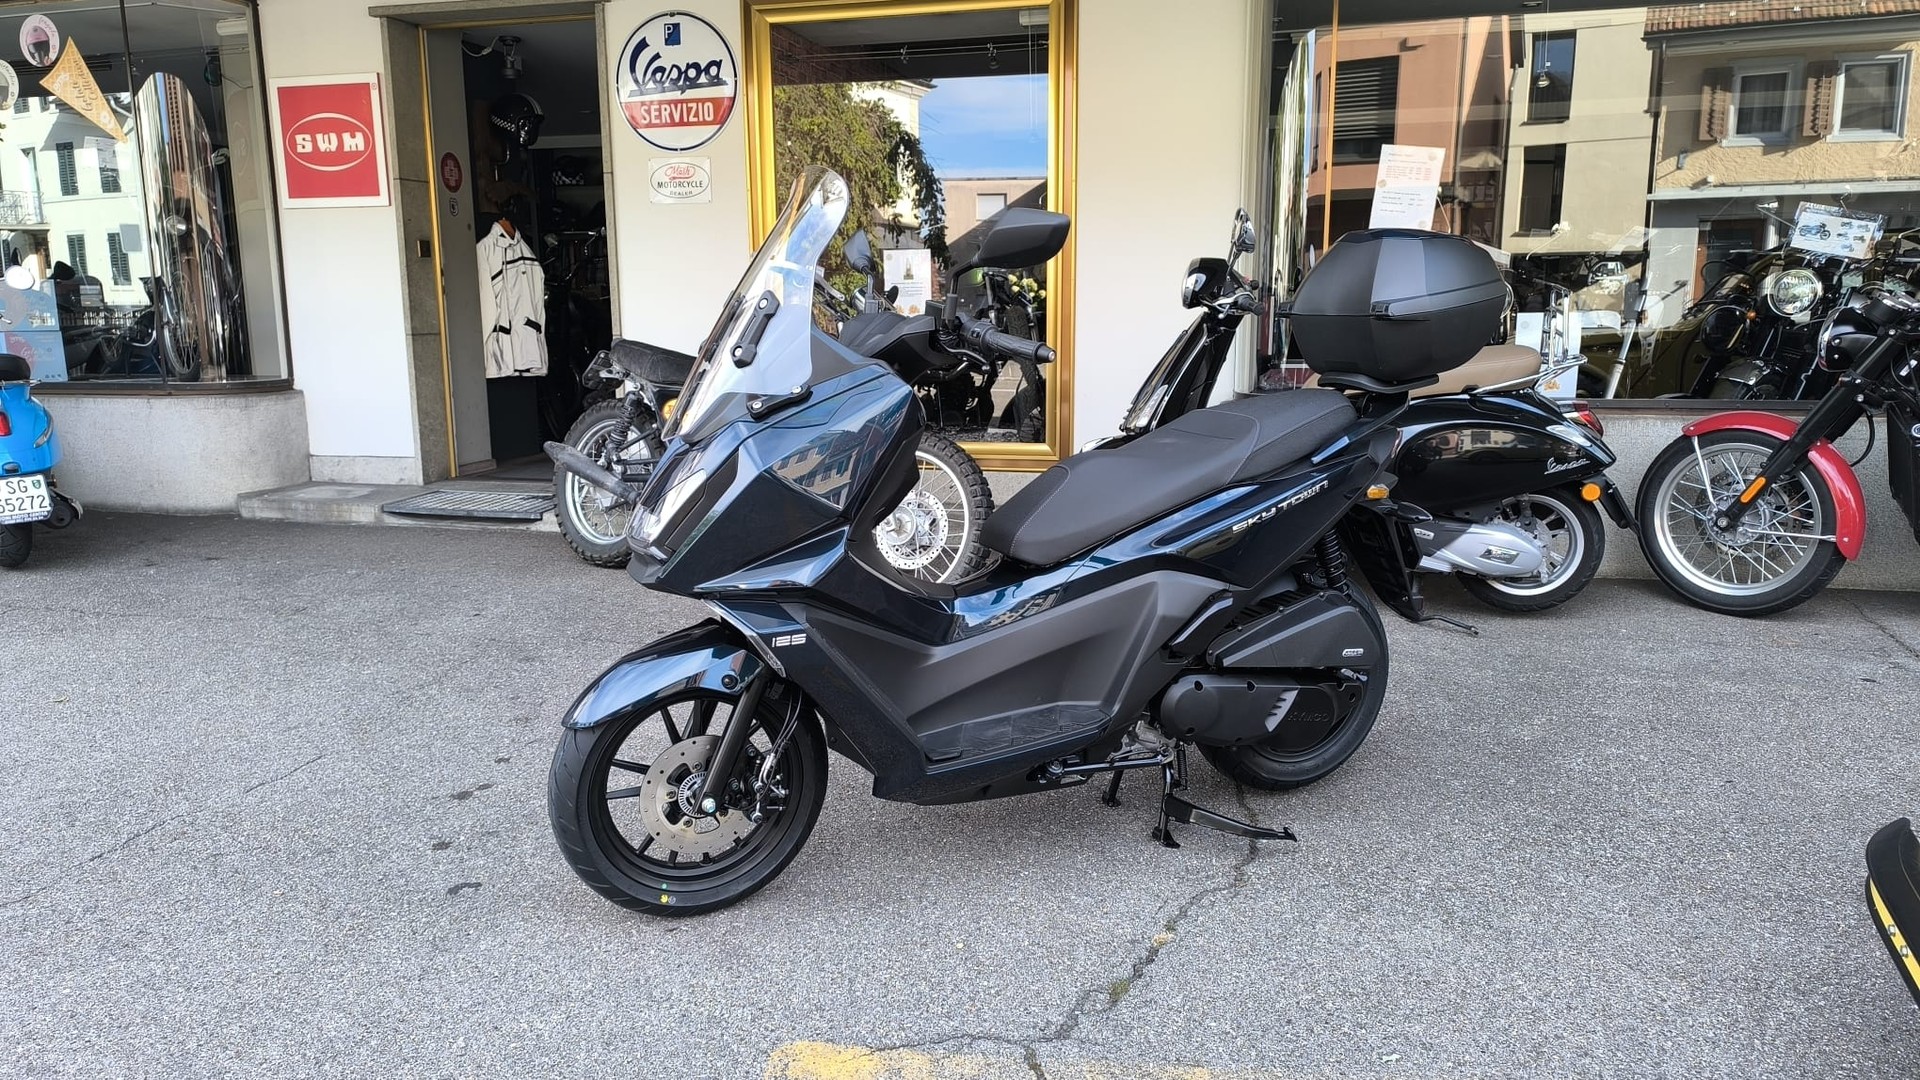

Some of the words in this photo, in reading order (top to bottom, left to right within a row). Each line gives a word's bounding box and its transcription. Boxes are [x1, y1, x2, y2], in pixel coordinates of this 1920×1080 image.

[628, 36, 728, 97] Vespa
[640, 101, 715, 125] SERVIZIO
[294, 131, 366, 153] SWM
[657, 181, 704, 189] MOTORCYCLE
[1544, 456, 1591, 475] Vespa
[5, 479, 28, 495] SG
[771, 633, 807, 648] 125
